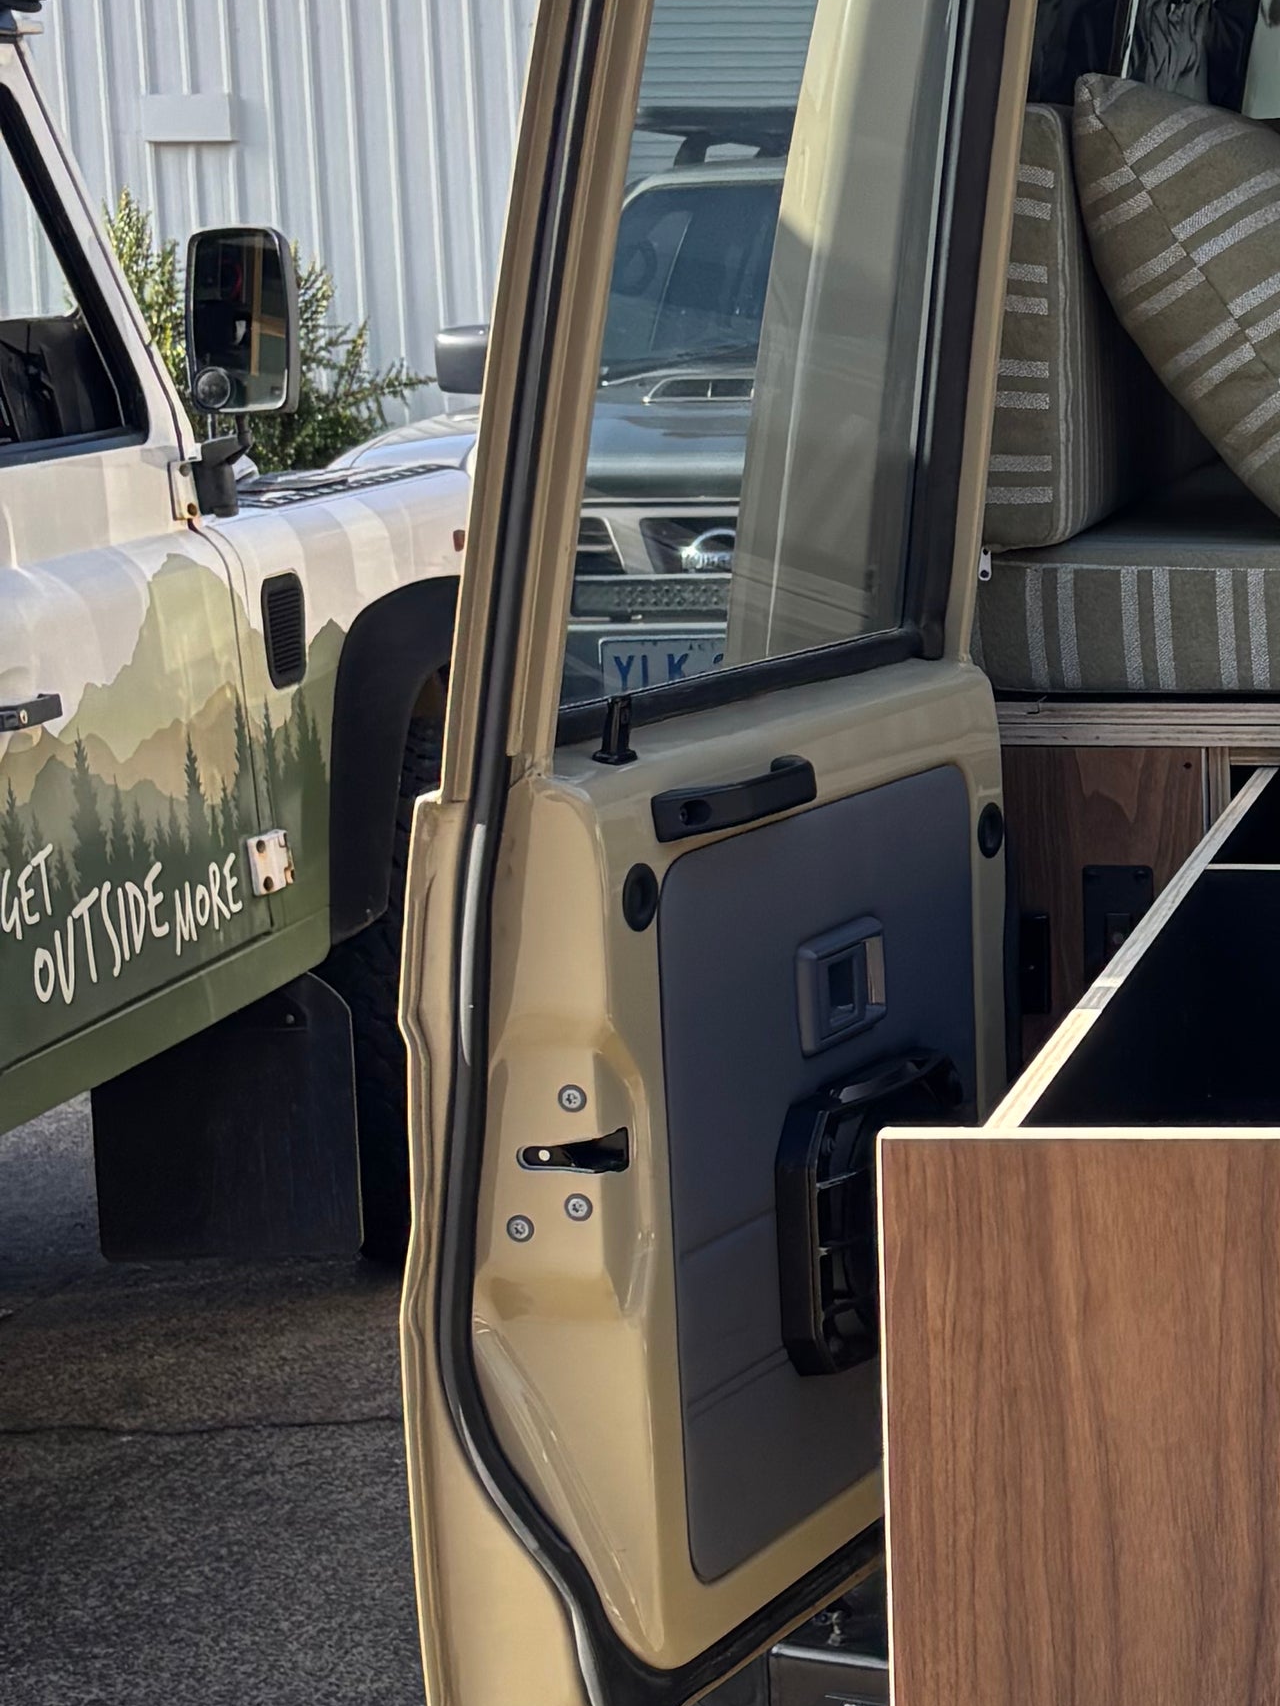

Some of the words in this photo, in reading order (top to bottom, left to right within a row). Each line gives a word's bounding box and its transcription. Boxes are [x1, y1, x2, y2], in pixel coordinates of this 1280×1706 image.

[0, 843, 54, 940] GET
[34, 861, 170, 1005] OUTSIDE
[175, 852, 243, 956] MORE
